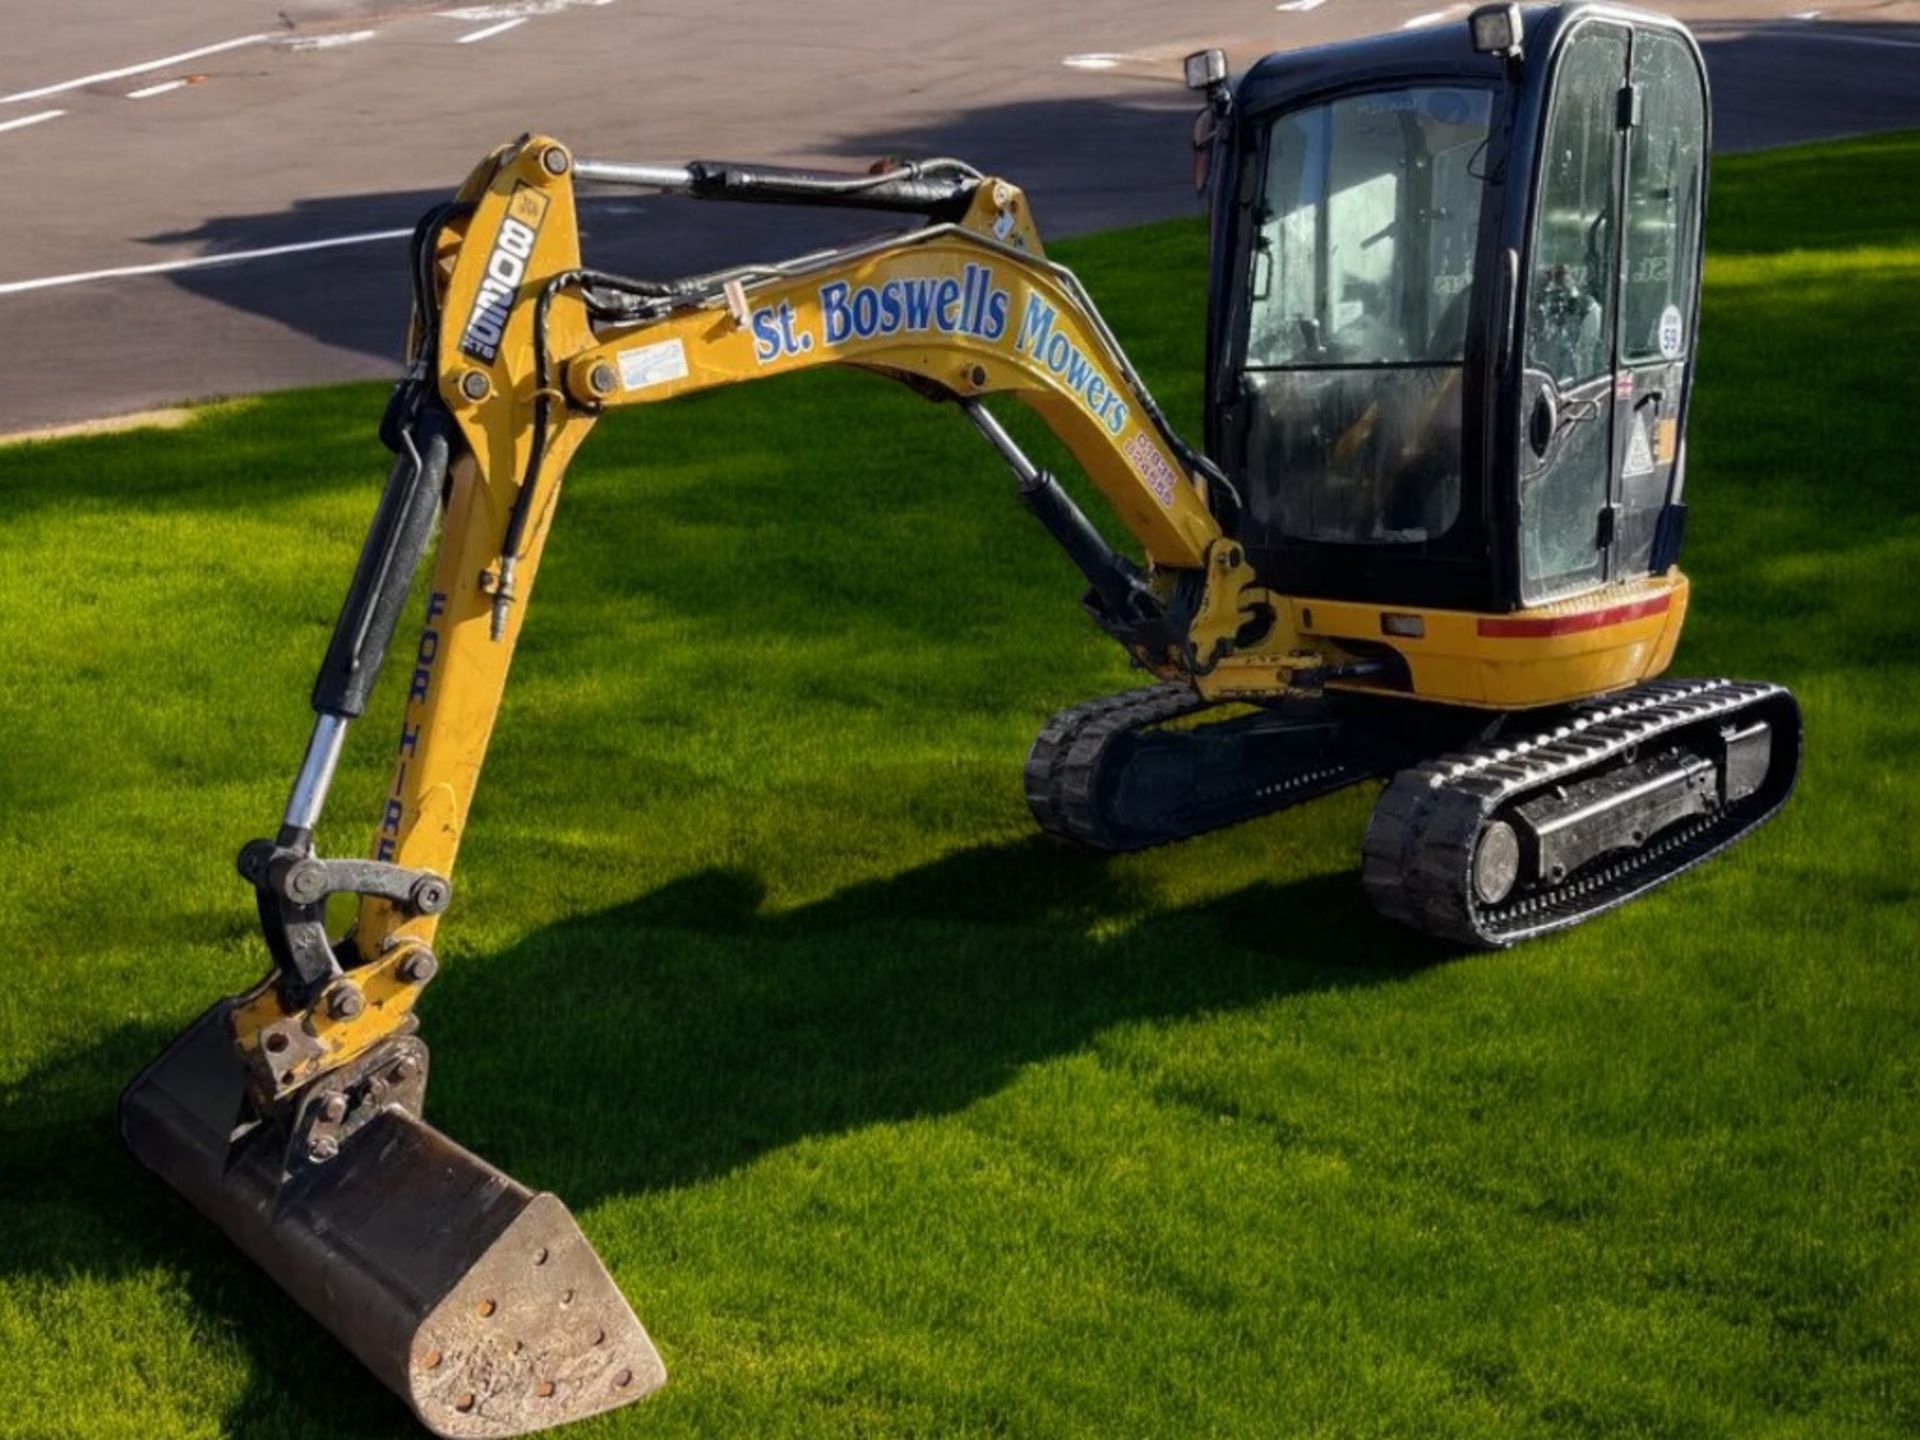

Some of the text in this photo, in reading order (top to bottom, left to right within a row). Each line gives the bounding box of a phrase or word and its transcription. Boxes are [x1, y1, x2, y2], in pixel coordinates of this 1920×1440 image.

[752, 264, 1129, 435] St. Boswells Mowers
[407, 593, 447, 704] FOR
